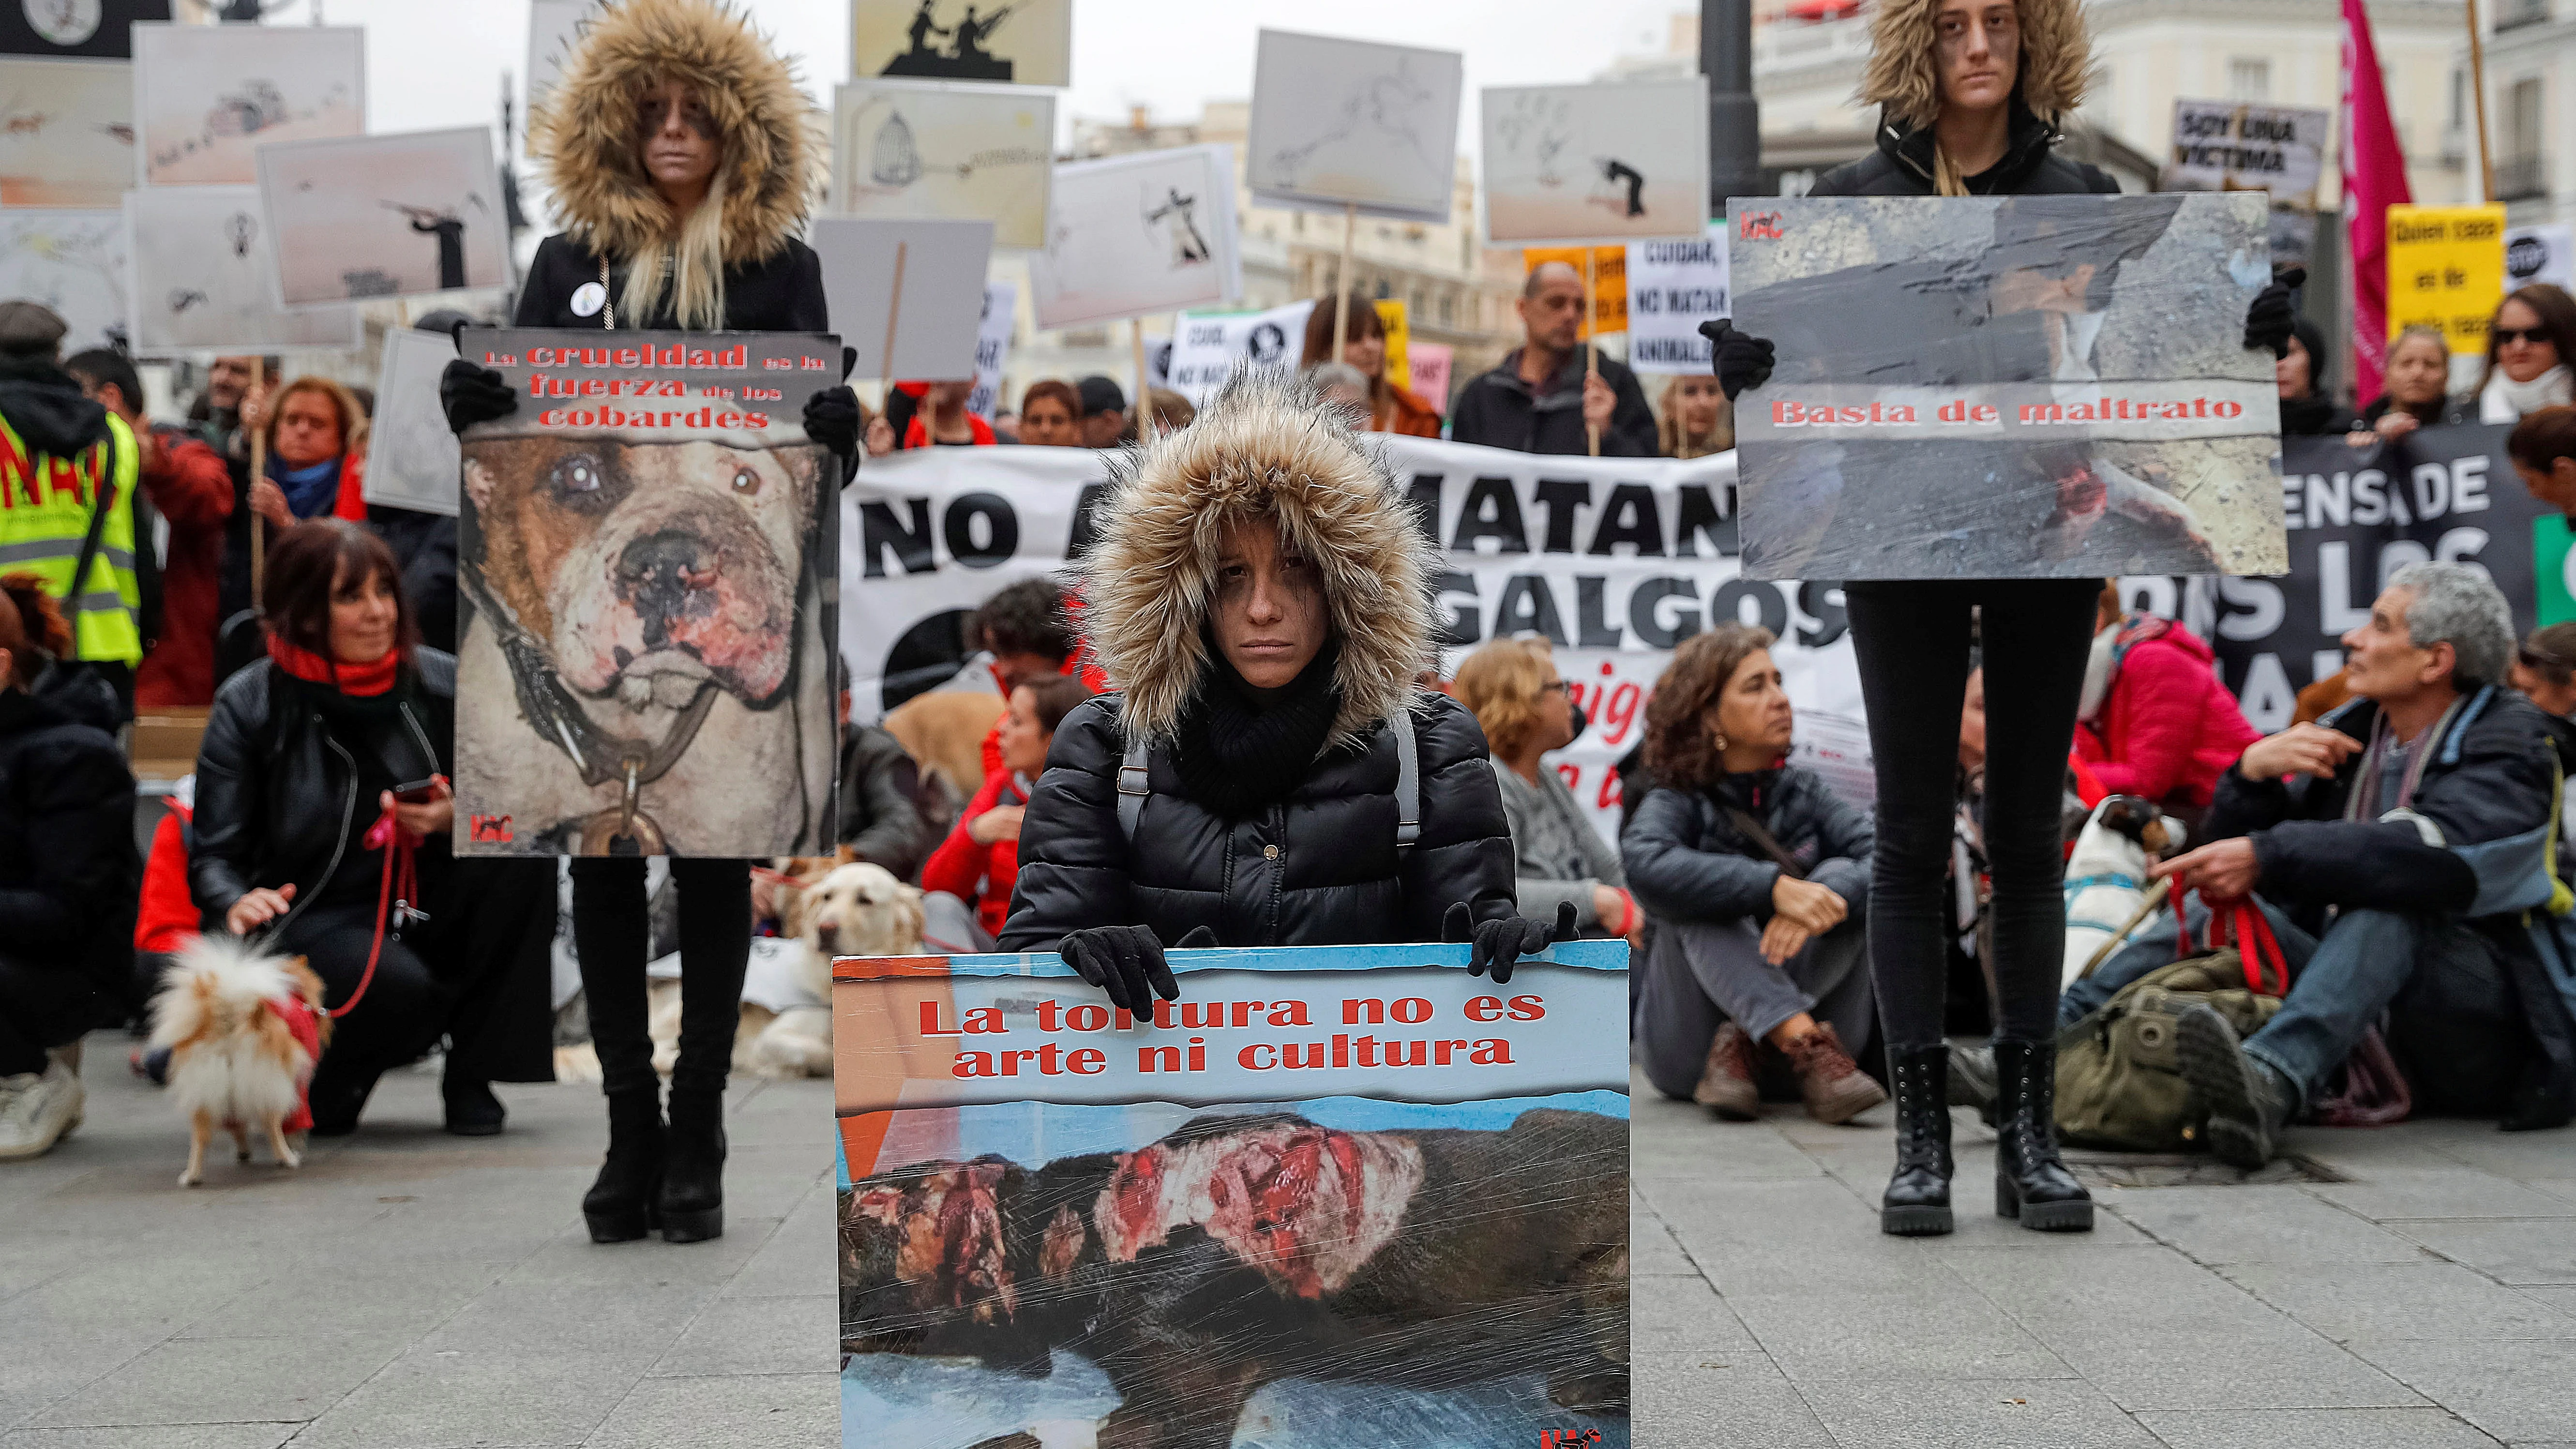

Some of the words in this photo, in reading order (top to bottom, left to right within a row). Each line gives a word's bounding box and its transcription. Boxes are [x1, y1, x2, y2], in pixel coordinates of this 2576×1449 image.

[2182, 111, 2230, 136] SOY
[2240, 117, 2295, 141] UNA
[2182, 146, 2285, 172] VICTIMA
[1637, 289, 1658, 312] NO
[1668, 288, 1726, 312] MATAR
[485, 351, 517, 366] La
[526, 343, 747, 368] crueldad
[763, 358, 793, 370] es
[800, 356, 825, 370] la
[529, 373, 686, 399] fuerza
[703, 386, 735, 400] de
[742, 386, 783, 401] los
[539, 405, 768, 429] cobardes
[1772, 401, 1918, 426] Basta
[1937, 399, 2000, 425] de
[2019, 396, 2242, 424] maltrato
[2412, 455, 2490, 521] DE
[860, 492, 1018, 577] NO
[1433, 574, 1850, 648] GALGOS
[471, 814, 513, 842] NAC
[920, 1000, 1009, 1036] La
[1342, 997, 1434, 1025] no
[1463, 994, 1546, 1022] es
[951, 1042, 1107, 1080] arte
[1138, 1037, 1207, 1073] ni
[1237, 1033, 1516, 1070] cultura
